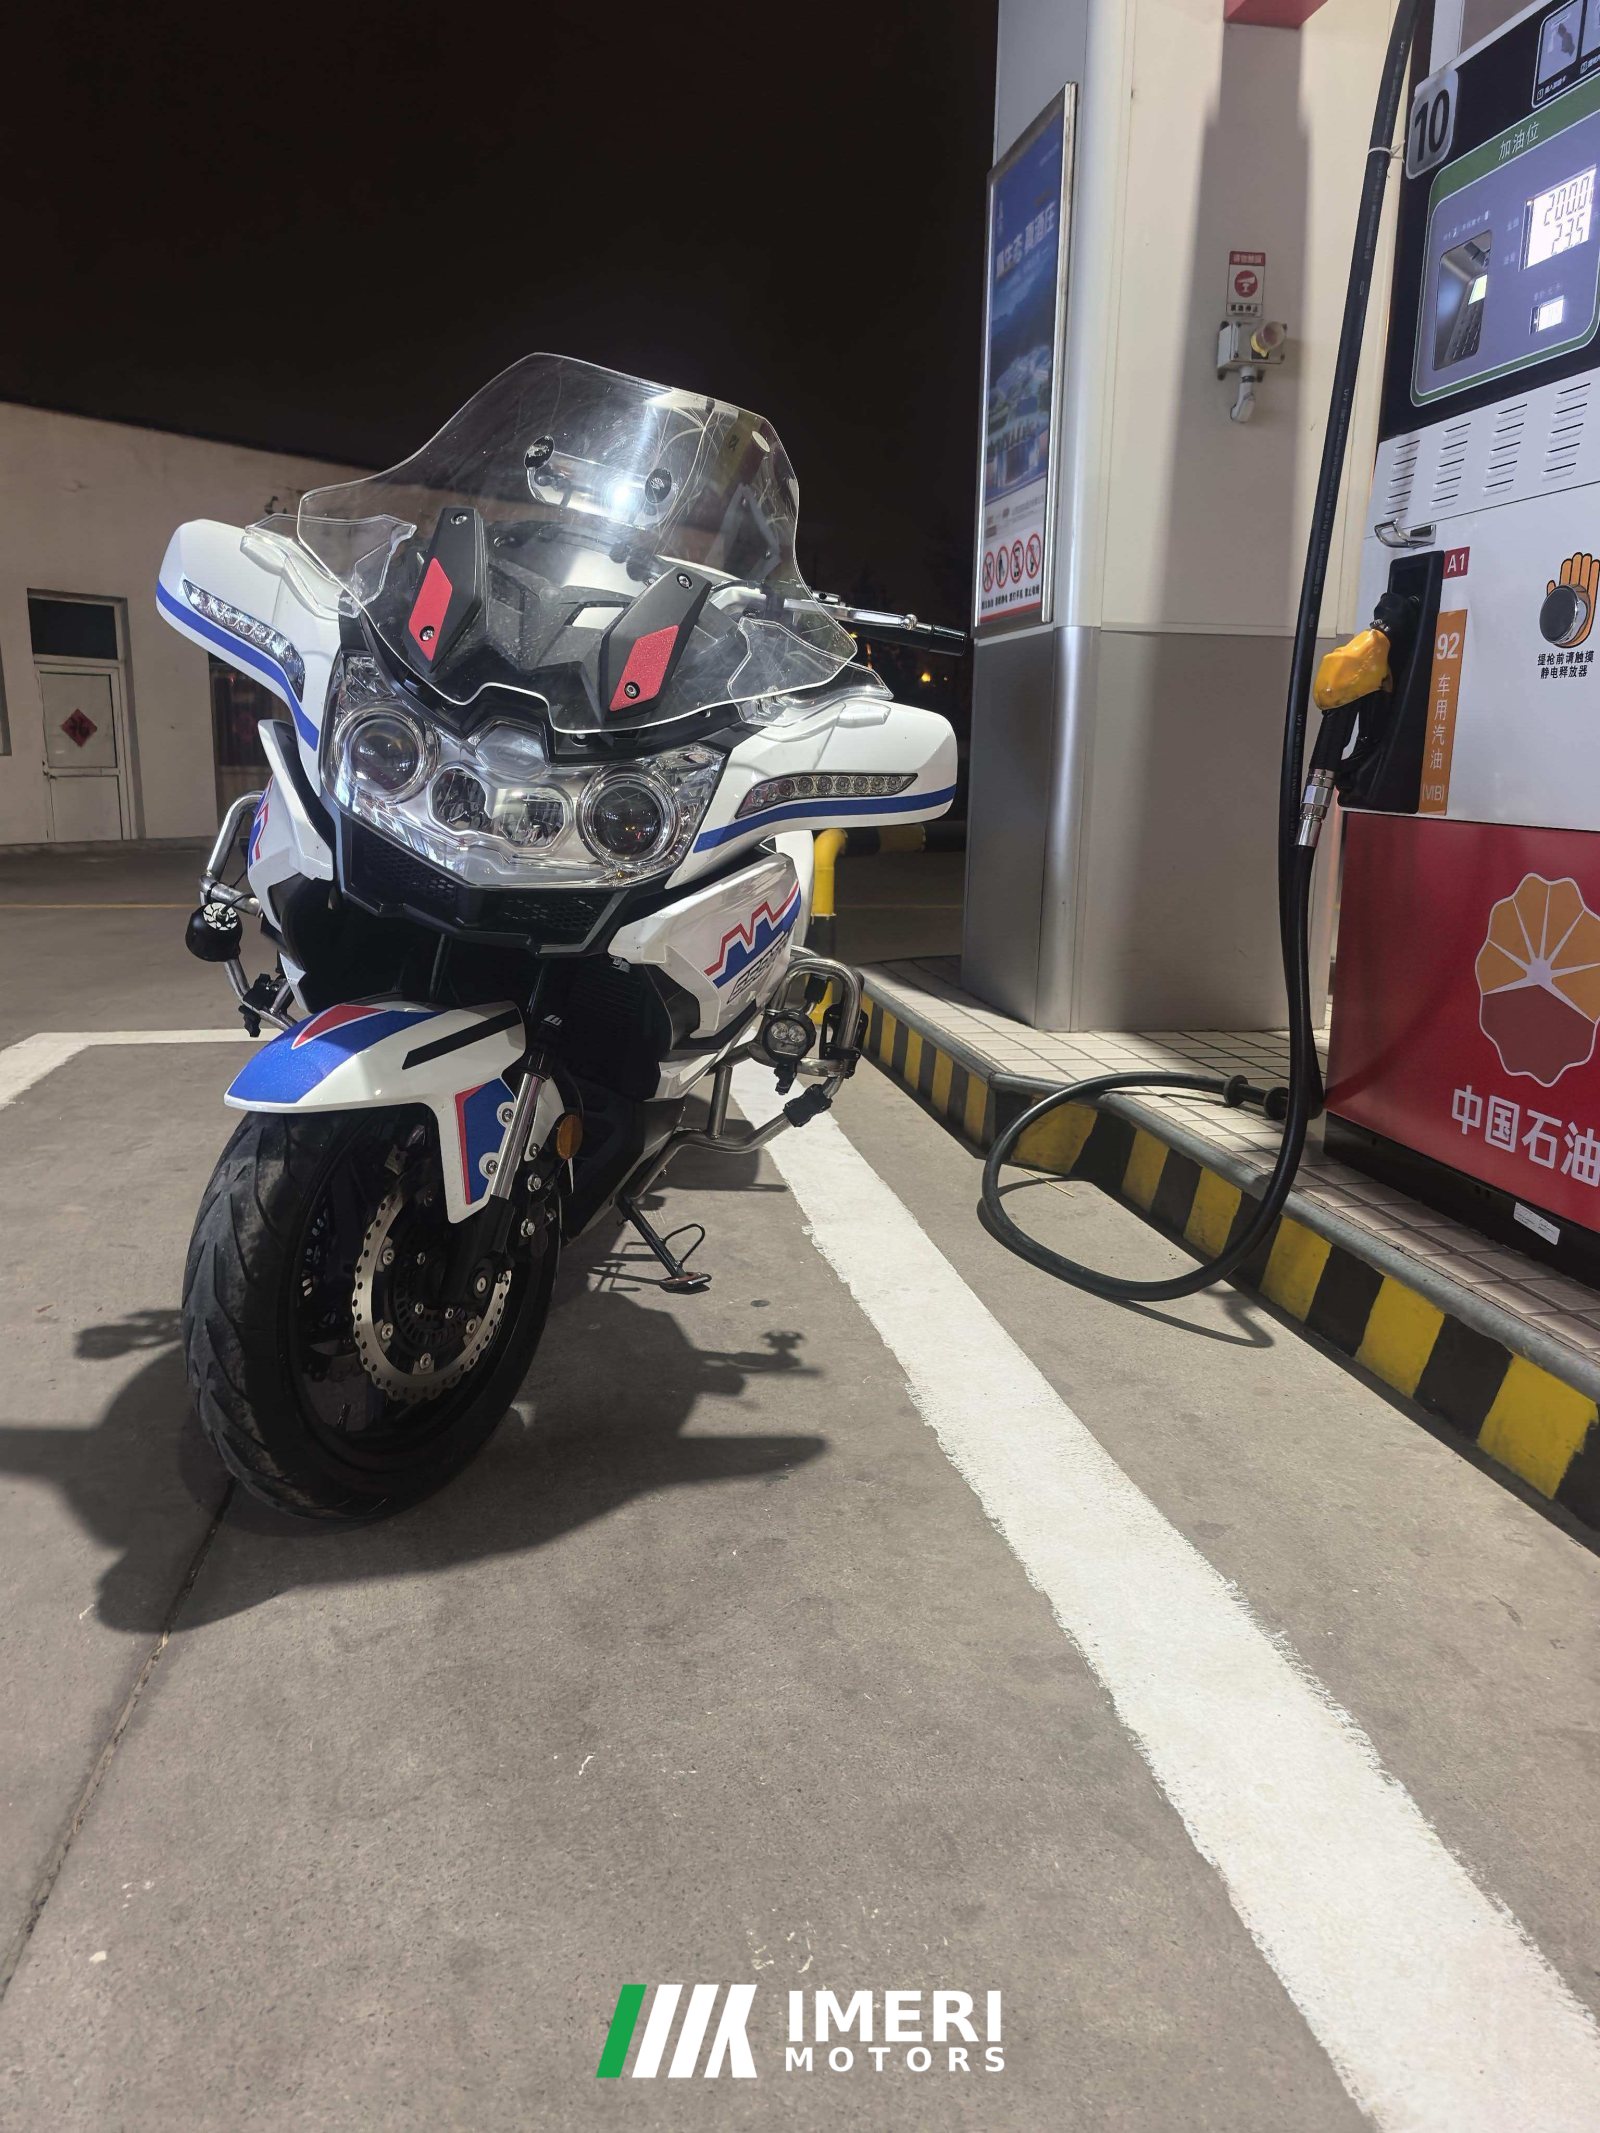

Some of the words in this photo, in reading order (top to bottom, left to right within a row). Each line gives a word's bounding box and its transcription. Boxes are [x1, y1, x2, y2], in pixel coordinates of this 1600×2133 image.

[1414, 89, 1450, 163] 10
[1499, 121, 1539, 161] 加油位
[1447, 553, 1466, 574] A1
[1436, 632, 1459, 660] 92
[1540, 665, 1588, 679] 静电释放器
[1430, 674, 1451, 769] 车用汽油
[1452, 1084, 1600, 1188] 中国石油
